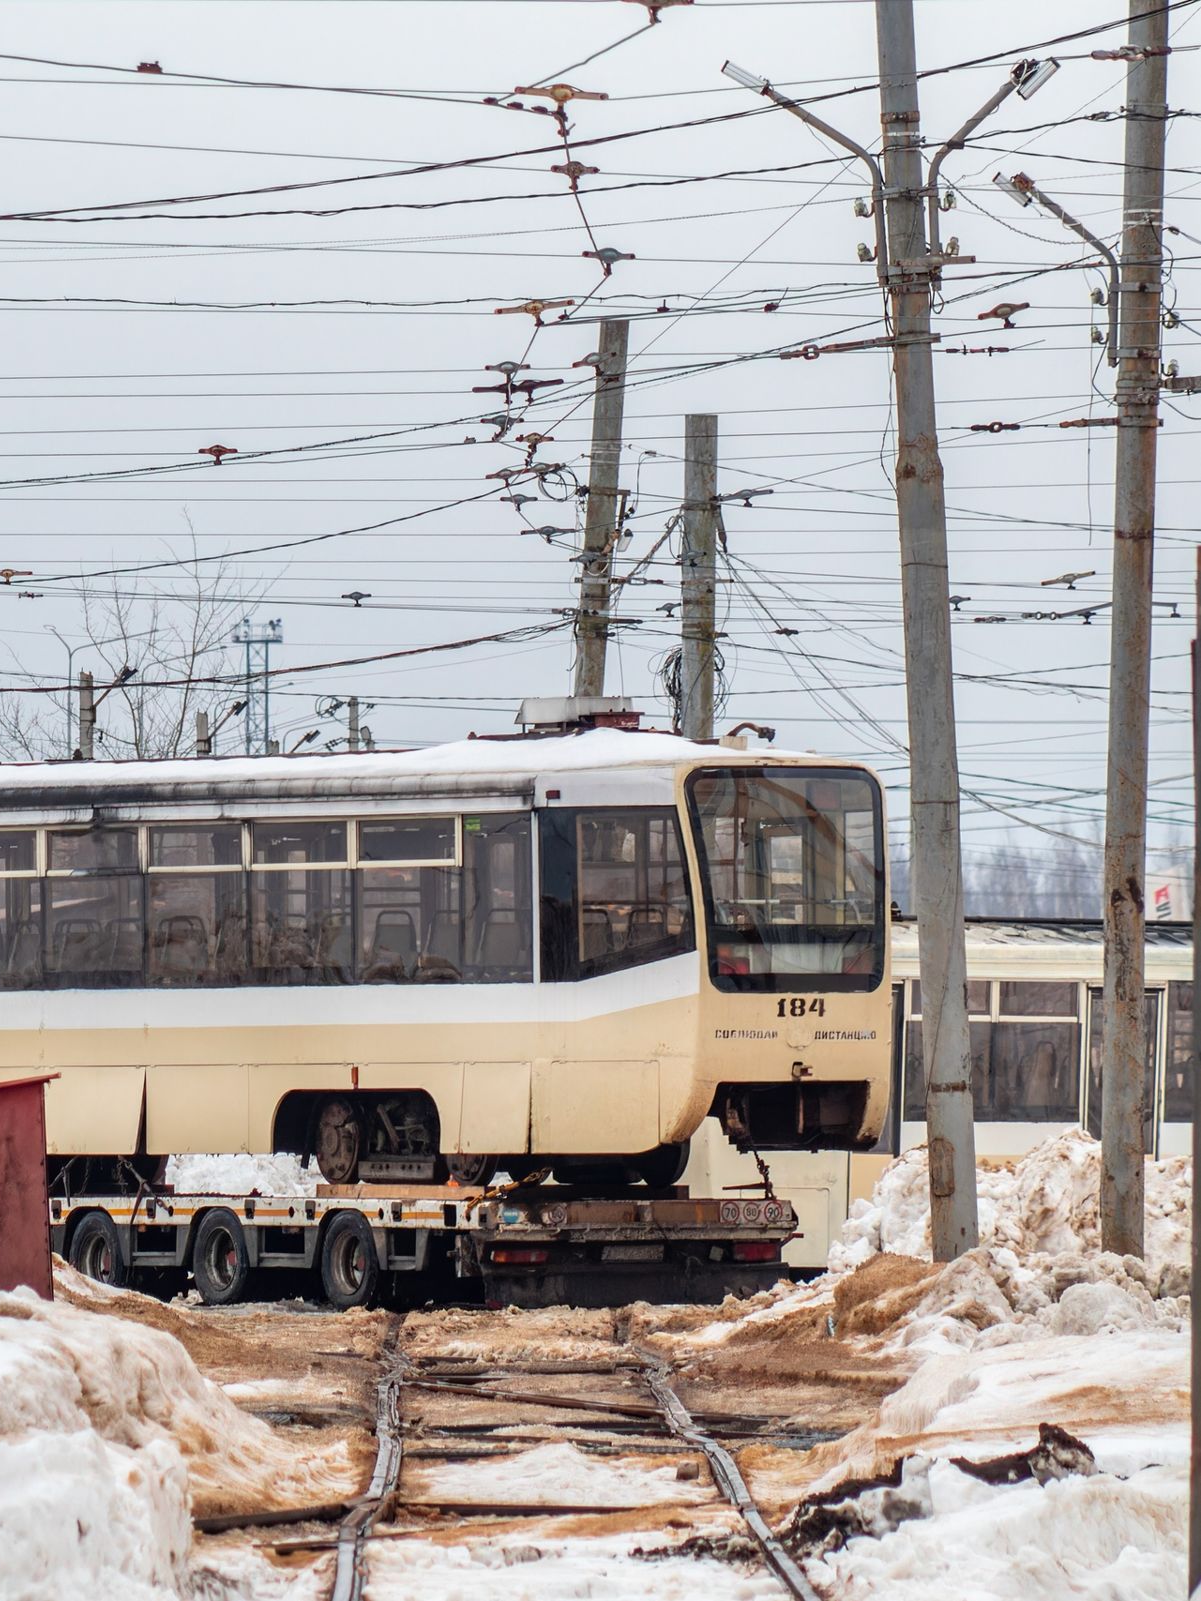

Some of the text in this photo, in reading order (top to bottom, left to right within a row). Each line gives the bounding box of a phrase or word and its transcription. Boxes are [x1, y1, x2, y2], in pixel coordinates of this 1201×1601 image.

[777, 998, 826, 1017] 184
[724, 1207, 737, 1218] 70
[745, 1207, 757, 1217] 80
[767, 1207, 780, 1218] 90
